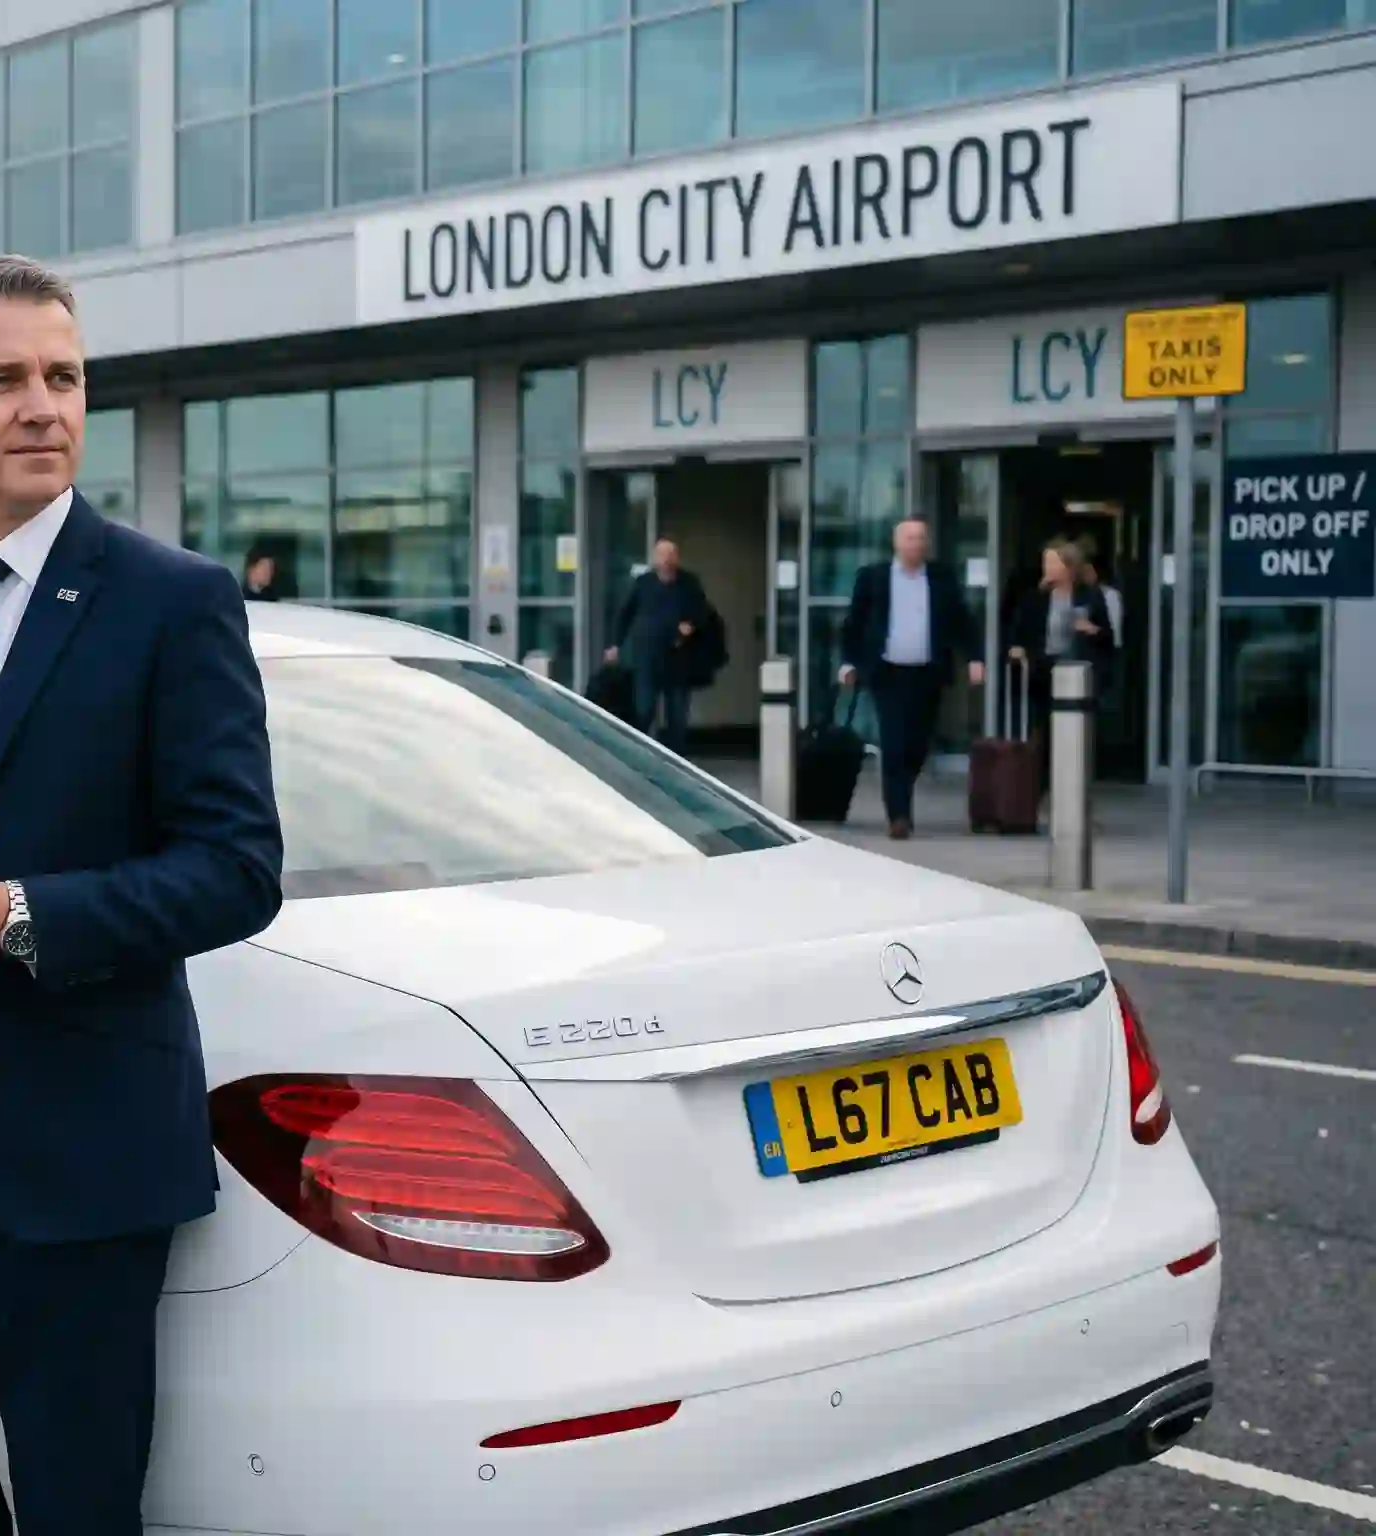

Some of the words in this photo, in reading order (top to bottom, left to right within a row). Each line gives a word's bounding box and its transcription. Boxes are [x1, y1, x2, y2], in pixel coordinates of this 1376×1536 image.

[403, 197, 612, 301] LONDON
[639, 171, 763, 271] CITY
[782, 117, 1091, 254] AIRPORT
[1146, 335, 1221, 361] TAXIS
[1011, 327, 1107, 403] LCY
[1148, 365, 1218, 388] ONLY
[651, 360, 727, 427] LCY
[1233, 475, 1299, 503] PICK
[1306, 473, 1346, 500] UP
[1228, 512, 1307, 540] DROP
[1311, 509, 1370, 538] OFF
[1260, 548, 1334, 576] ONLY
[796, 1069, 891, 1153] L67
[906, 1052, 1000, 1127] CAB
